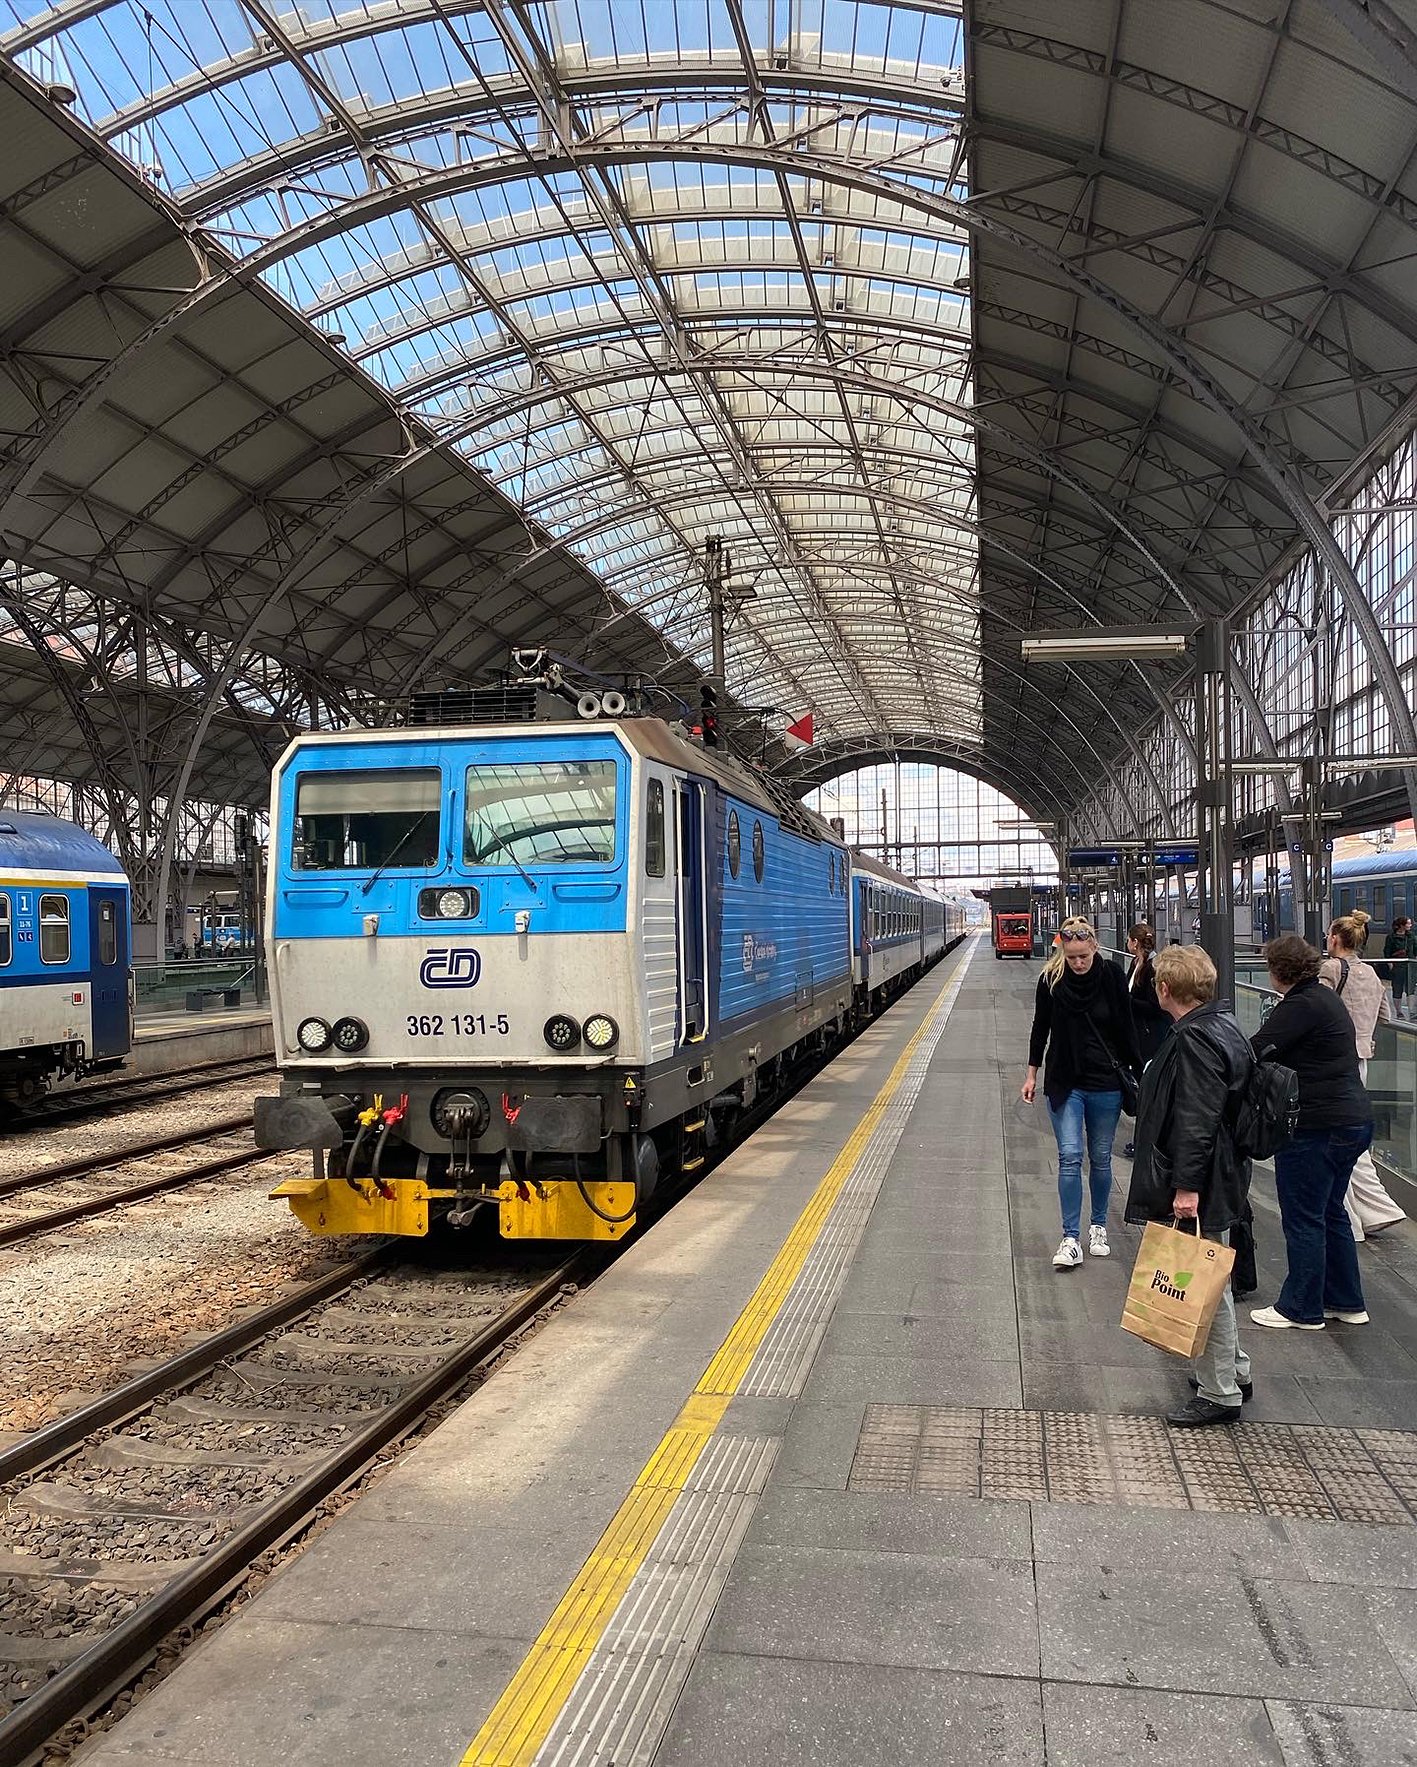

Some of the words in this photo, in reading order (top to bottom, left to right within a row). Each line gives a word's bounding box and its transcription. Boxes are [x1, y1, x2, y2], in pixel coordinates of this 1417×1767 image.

[21, 895, 29, 912] 1
[406, 1015, 445, 1036] 362
[450, 1014, 510, 1036] 131-5
[1154, 1269, 1170, 1283] Bio
[1150, 1277, 1186, 1302] Point
